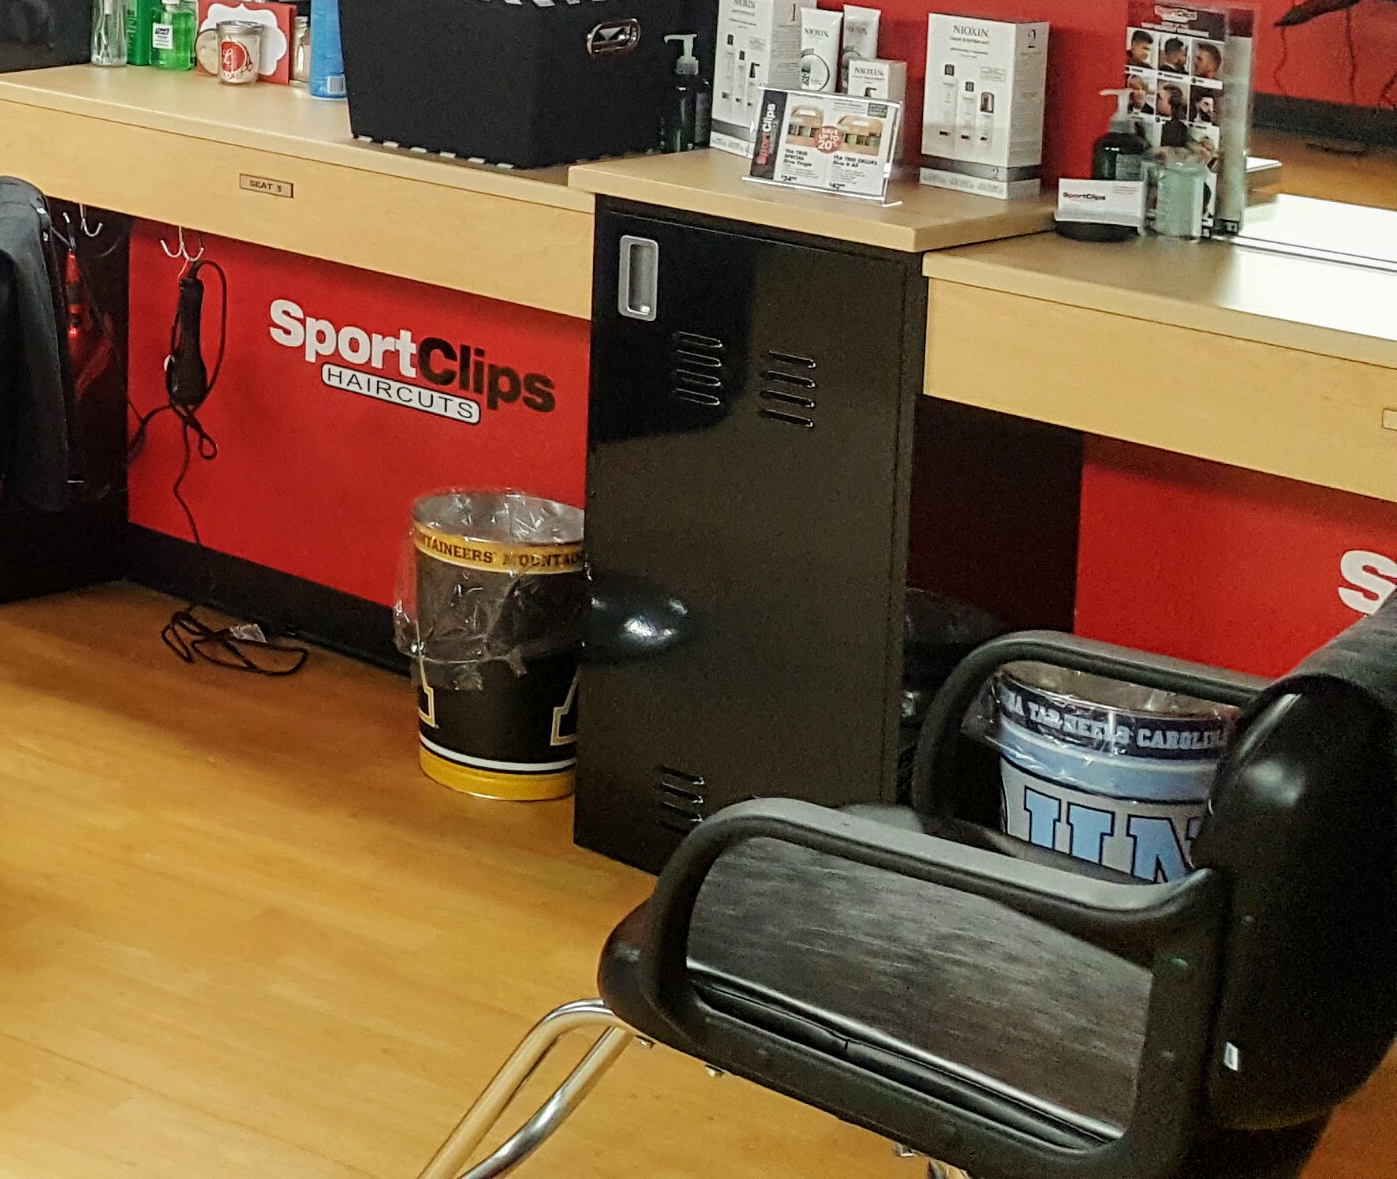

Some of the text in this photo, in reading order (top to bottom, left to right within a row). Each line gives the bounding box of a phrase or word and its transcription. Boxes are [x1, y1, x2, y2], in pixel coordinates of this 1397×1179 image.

[953, 25, 989, 38] NIOXIN
[1027, 29, 1037, 49] 2
[854, 67, 885, 77] NIOXIN
[249, 179, 274, 192] SEAT
[1062, 191, 1106, 201] SportClips
[269, 298, 557, 413] SportClips
[326, 367, 474, 420] HAIRCUTS
